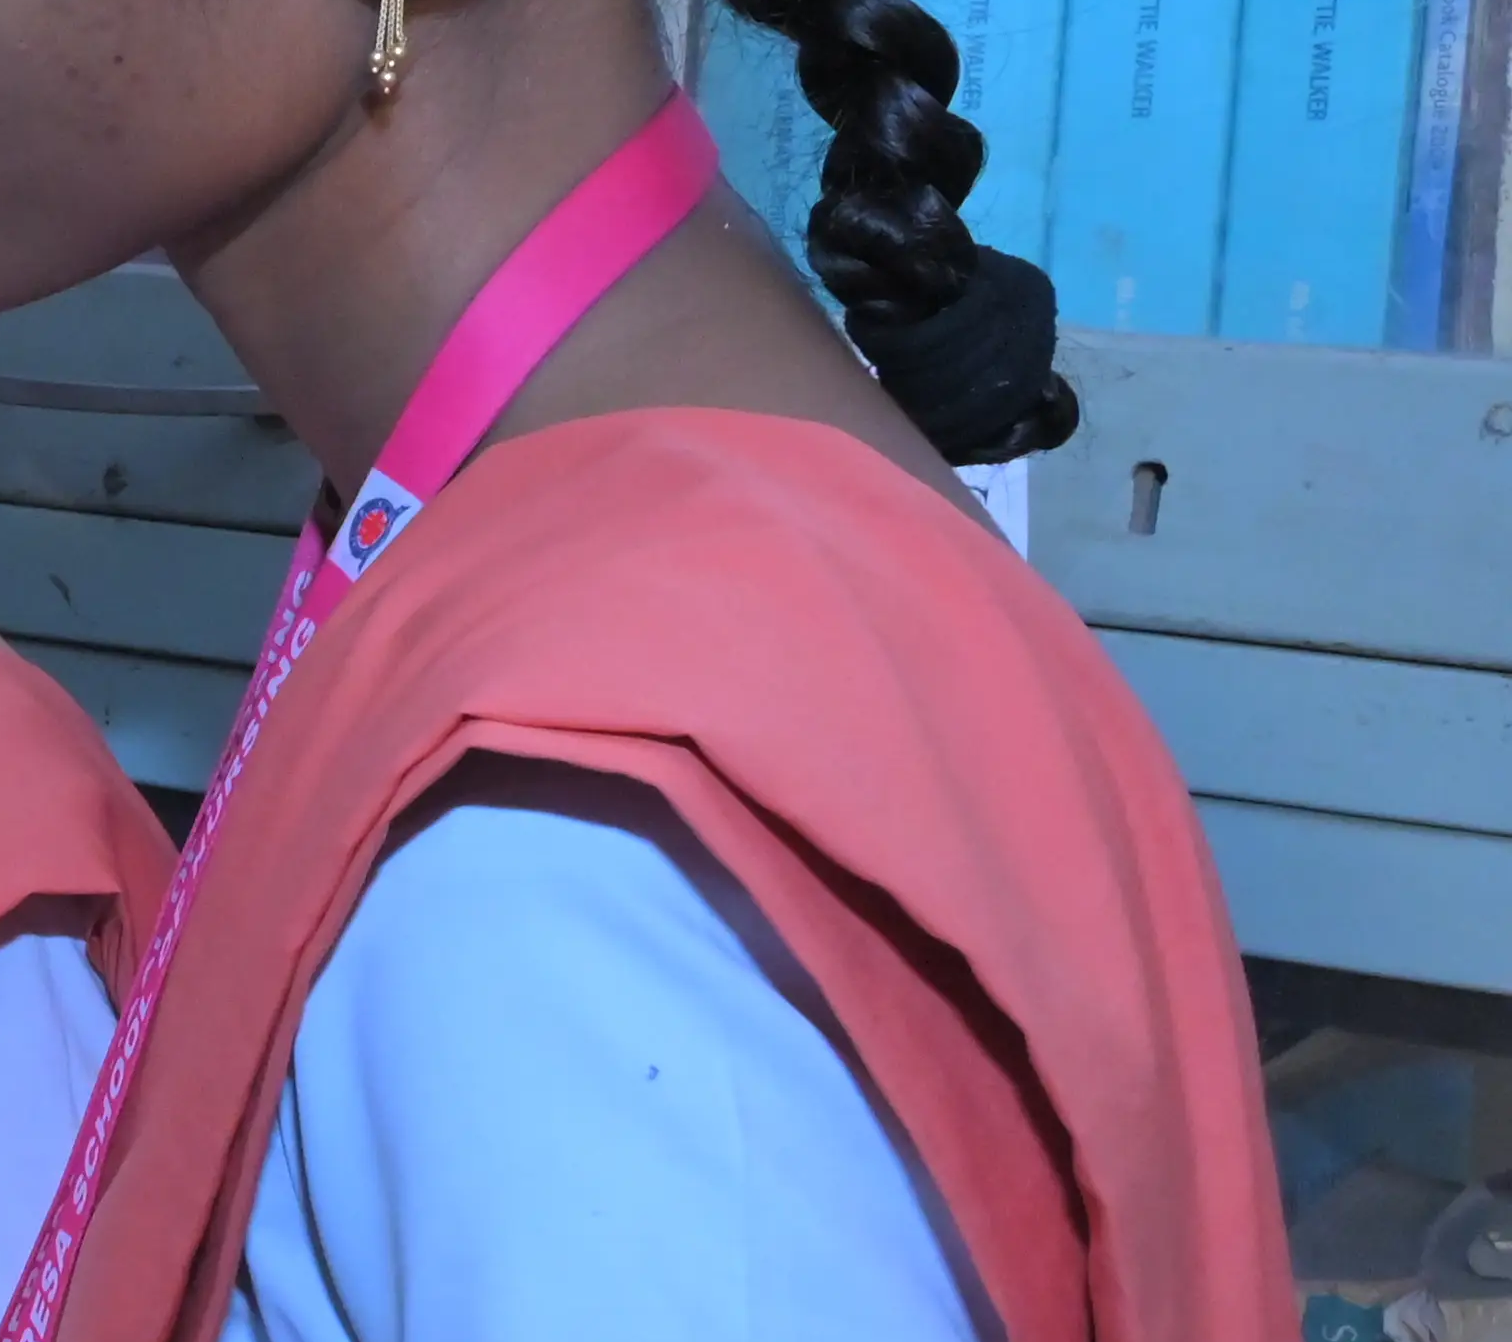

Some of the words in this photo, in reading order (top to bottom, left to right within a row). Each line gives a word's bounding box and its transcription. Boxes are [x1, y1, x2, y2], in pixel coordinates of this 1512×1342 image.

[1130, 40, 1157, 119] WALKER
[1306, 43, 1332, 122] WALKER
[71, 980, 156, 1216] SCHOOL
[191, 615, 319, 869] NURSING
